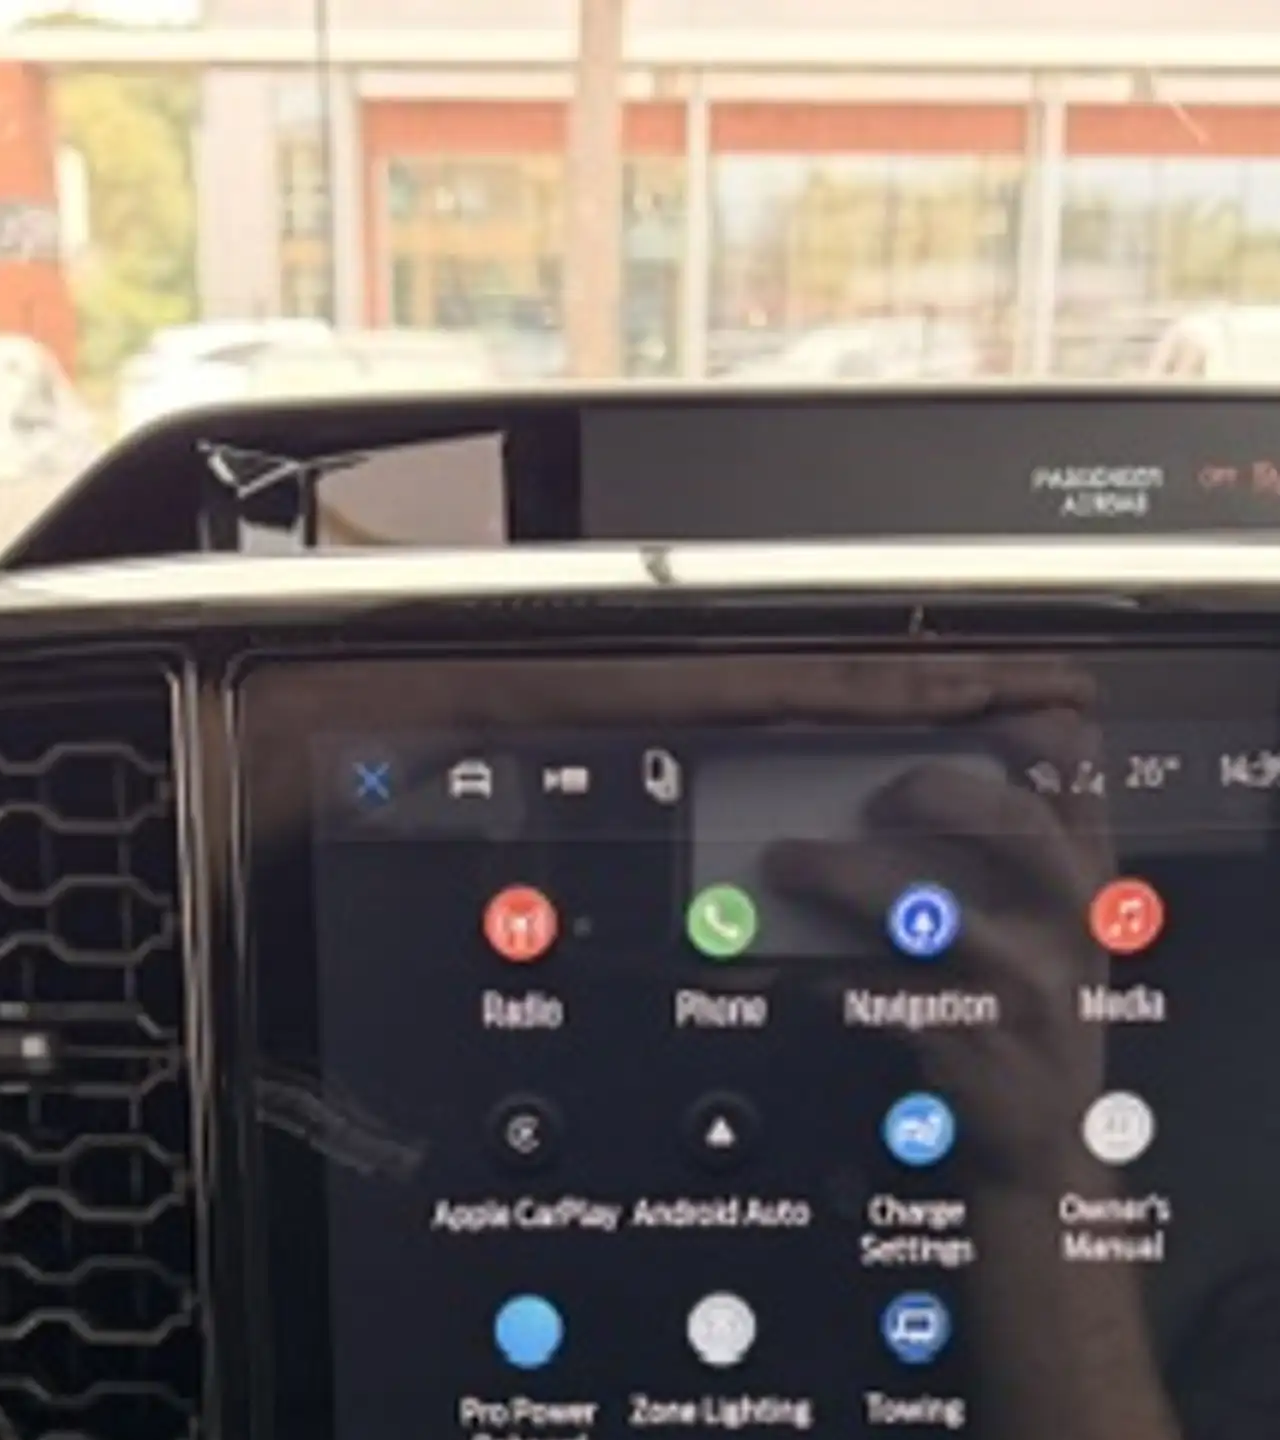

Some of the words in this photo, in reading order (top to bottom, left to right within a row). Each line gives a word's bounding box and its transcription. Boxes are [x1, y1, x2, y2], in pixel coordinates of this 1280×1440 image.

[483, 989, 564, 1029] Radio
[675, 988, 768, 1028] Phone
[844, 988, 999, 1031] Navigation
[1078, 984, 1166, 1023] Media
[431, 1199, 511, 1231] Apple
[515, 1198, 620, 1232] CarPlay
[631, 1198, 738, 1227] Android
[744, 1199, 811, 1228] Auto
[869, 1194, 966, 1230] Charge
[1058, 1193, 1170, 1225] Owner's
[861, 1233, 975, 1268] Settings
[1063, 1229, 1166, 1262] Manual
[459, 1397, 509, 1427] Pro
[513, 1397, 598, 1426] Power
[628, 1394, 698, 1426] Zone
[702, 1394, 814, 1430] Lighting
[864, 1391, 967, 1430] Towing
